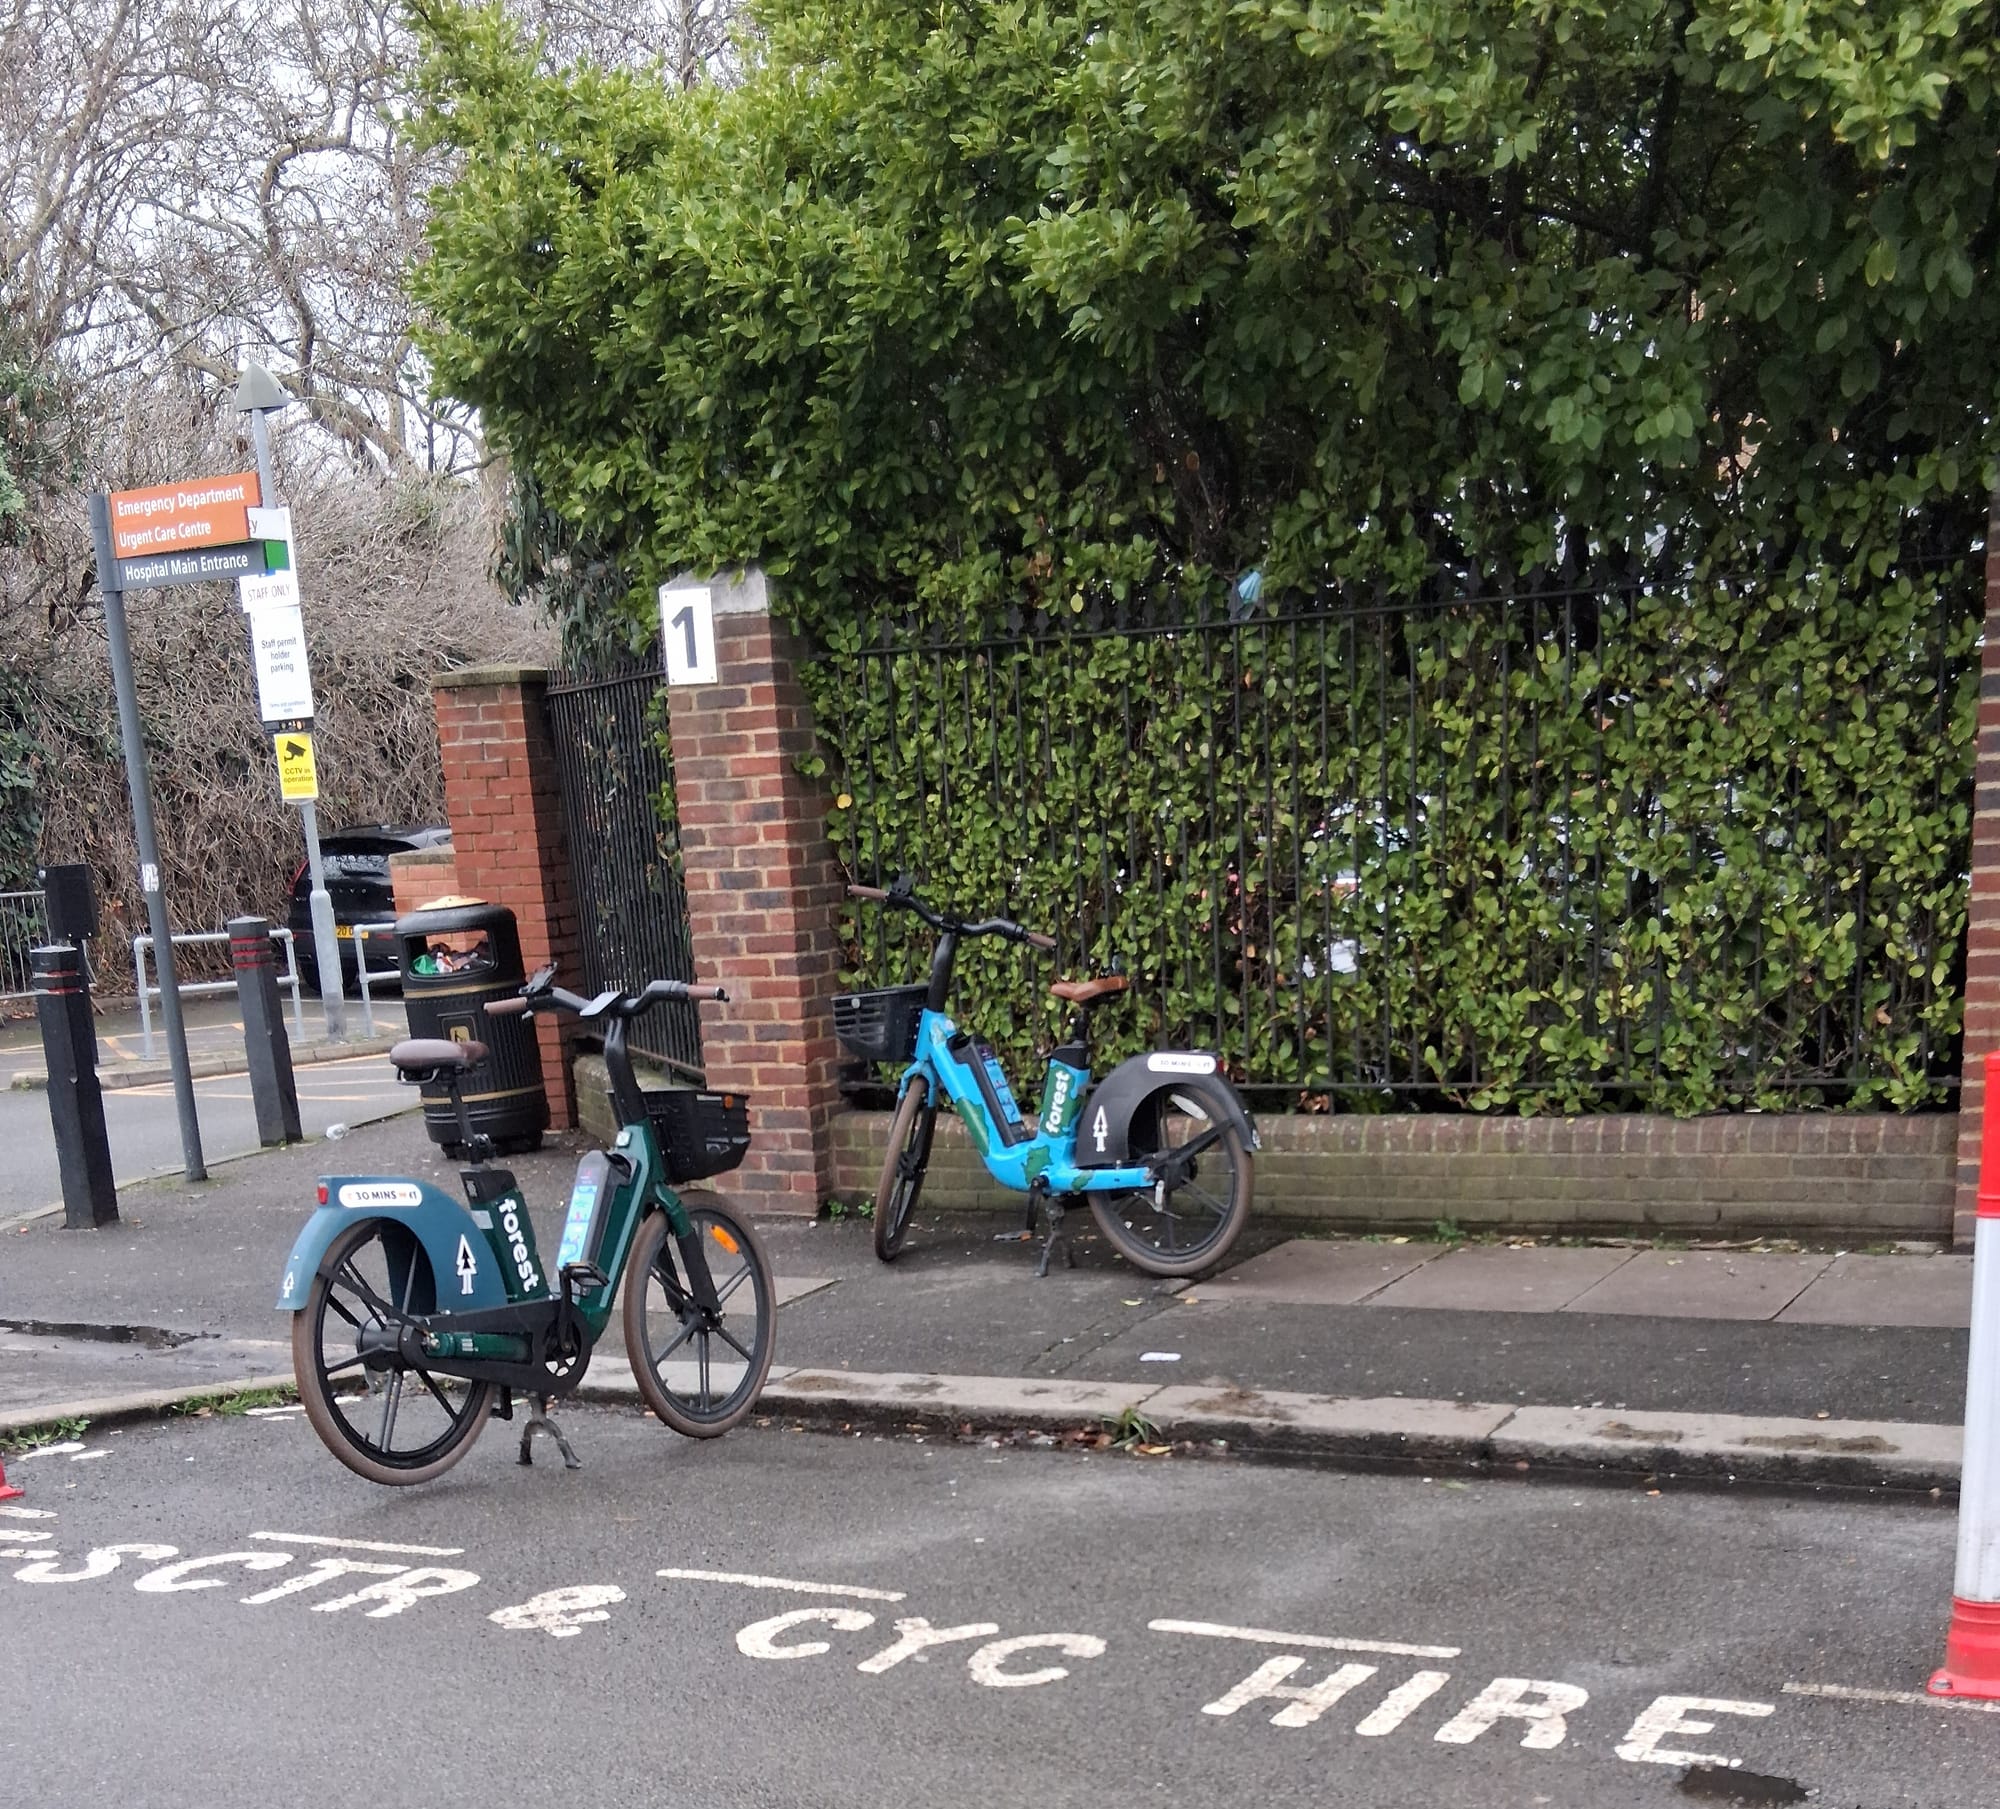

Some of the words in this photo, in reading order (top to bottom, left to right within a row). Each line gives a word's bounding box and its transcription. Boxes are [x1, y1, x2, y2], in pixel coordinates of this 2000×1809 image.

[117, 497, 175, 517] Emergency
[178, 485, 245, 509] Department
[120, 529, 153, 548] Urgent
[154, 525, 177, 542] Care
[178, 521, 212, 539] Centre
[125, 559, 169, 582] Hospital
[171, 557, 198, 576] Main
[200, 553, 249, 573] Entrance
[247, 587, 269, 602] STAFF
[271, 584, 290, 598] ONLY
[261, 638, 276, 650] Staff
[277, 636, 297, 649] permit
[671, 606, 698, 669] 1
[270, 650, 290, 660] holder
[270, 662, 294, 673] parking
[284, 767, 303, 775] CCTV
[1045, 1070, 1071, 1133] forest
[371, 1190, 397, 1200] MINS
[498, 1198, 539, 1293] forest
[735, 1607, 1107, 1687] CYC
[1200, 1654, 1776, 1768] HIRE
